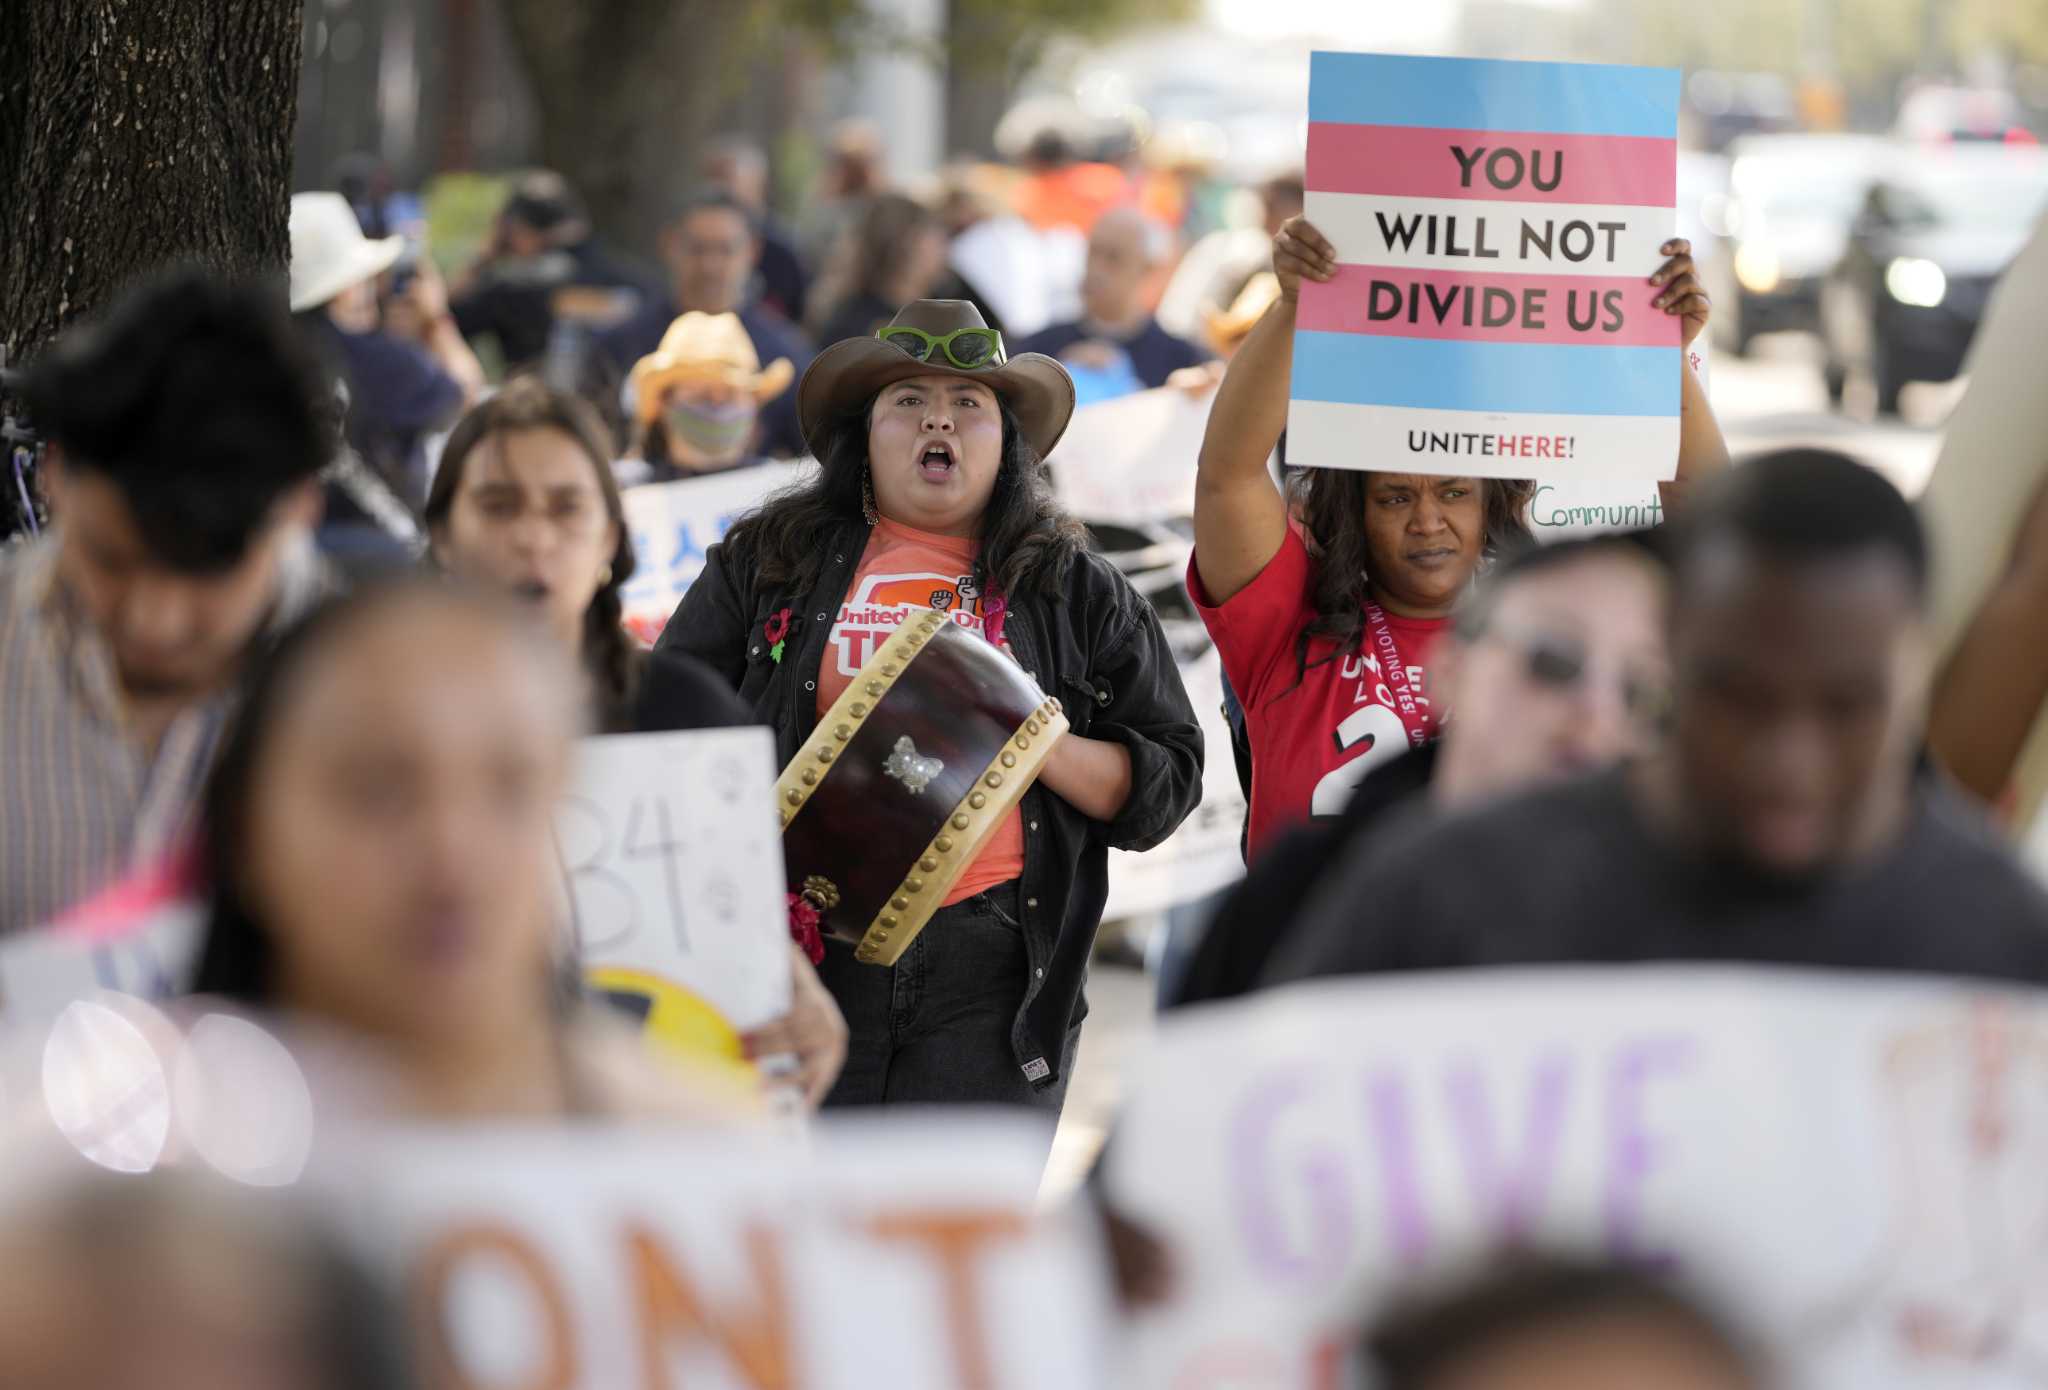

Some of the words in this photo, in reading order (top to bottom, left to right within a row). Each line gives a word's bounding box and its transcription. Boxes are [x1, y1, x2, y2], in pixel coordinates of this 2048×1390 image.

[1450, 146, 1563, 191] YOU
[1375, 212, 1499, 258] WILL
[1519, 219, 1626, 263] NOT
[1368, 281, 1546, 329] DIVIDE
[1567, 289, 1625, 333] US
[1531, 485, 1662, 528] Communit
[837, 607, 909, 625] United
[1375, 624, 1405, 681] VOTING
[1395, 681, 1417, 715] YES!
[1226, 1034, 1698, 1290] GIVE
